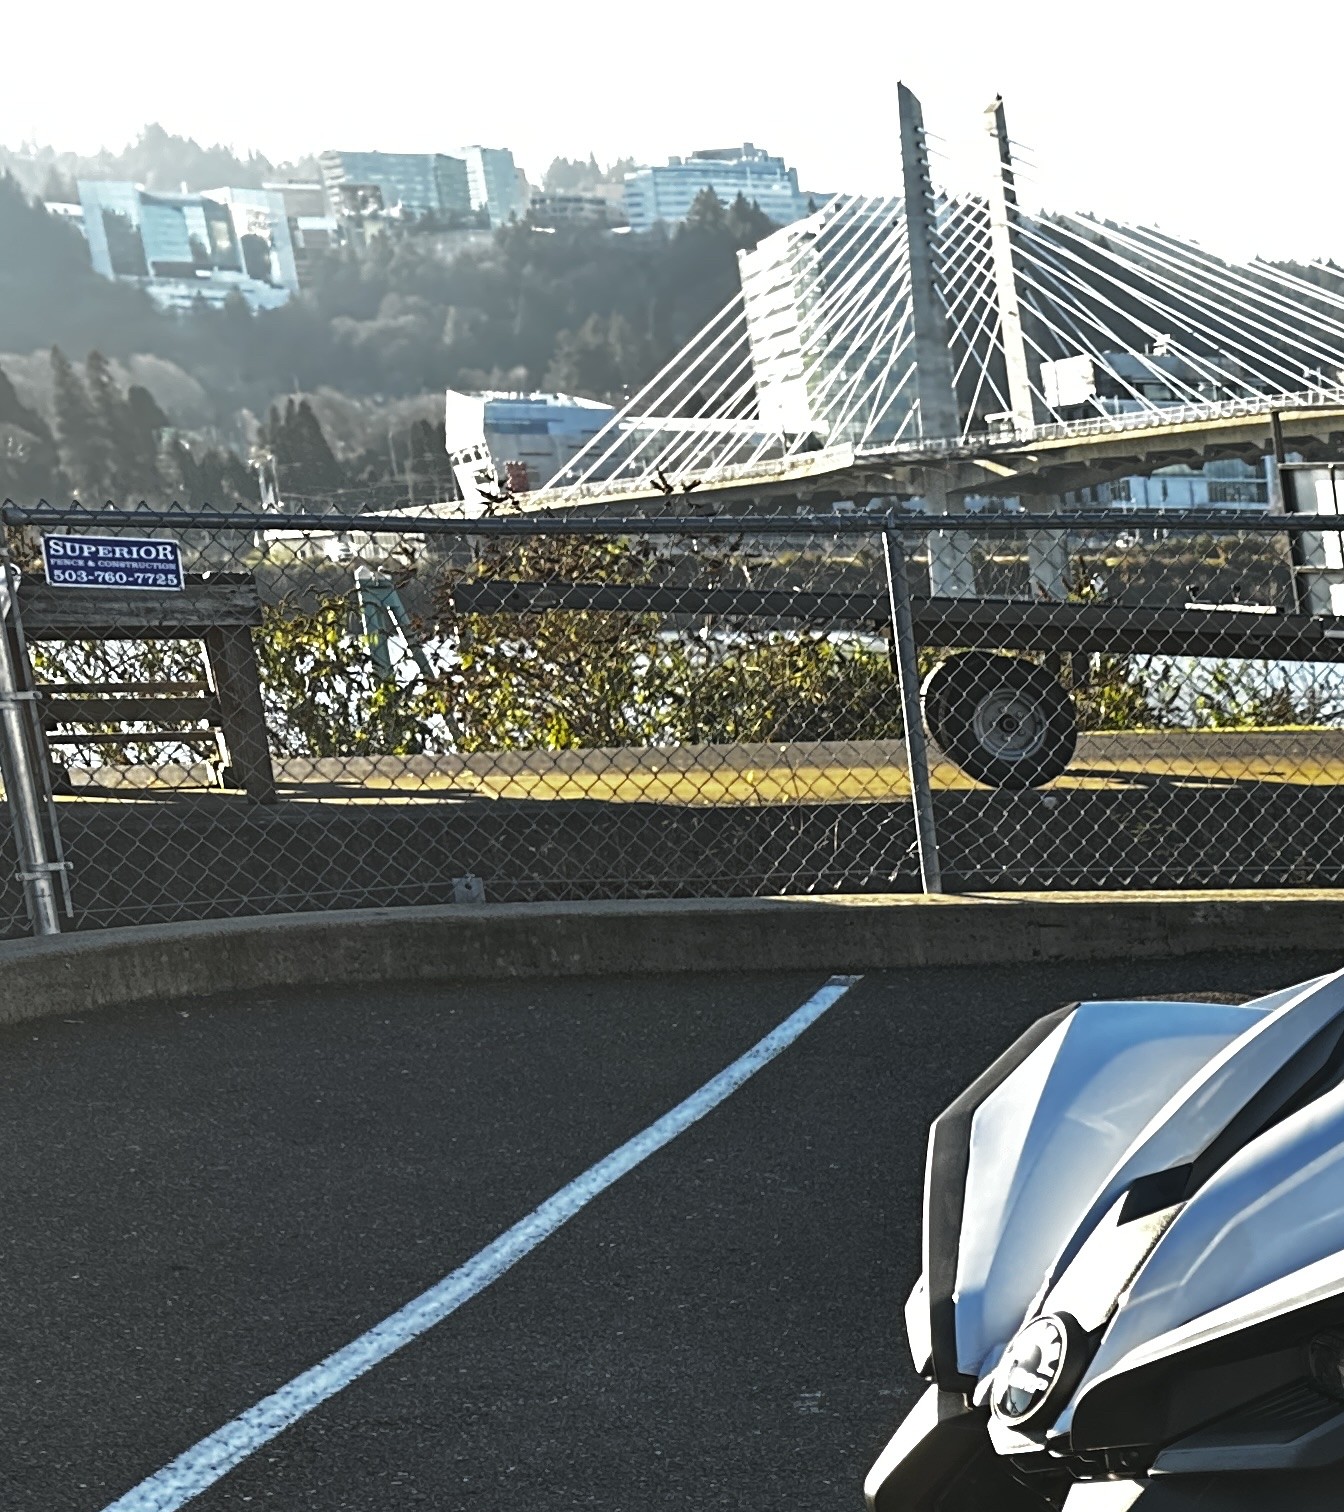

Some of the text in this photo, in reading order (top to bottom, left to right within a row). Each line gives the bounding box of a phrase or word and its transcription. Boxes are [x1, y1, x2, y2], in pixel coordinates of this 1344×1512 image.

[49, 539, 175, 561] SUPERIOR
[50, 558, 177, 570] FENCE & CONSTRUCTION
[53, 569, 178, 586] 503-760-7725
